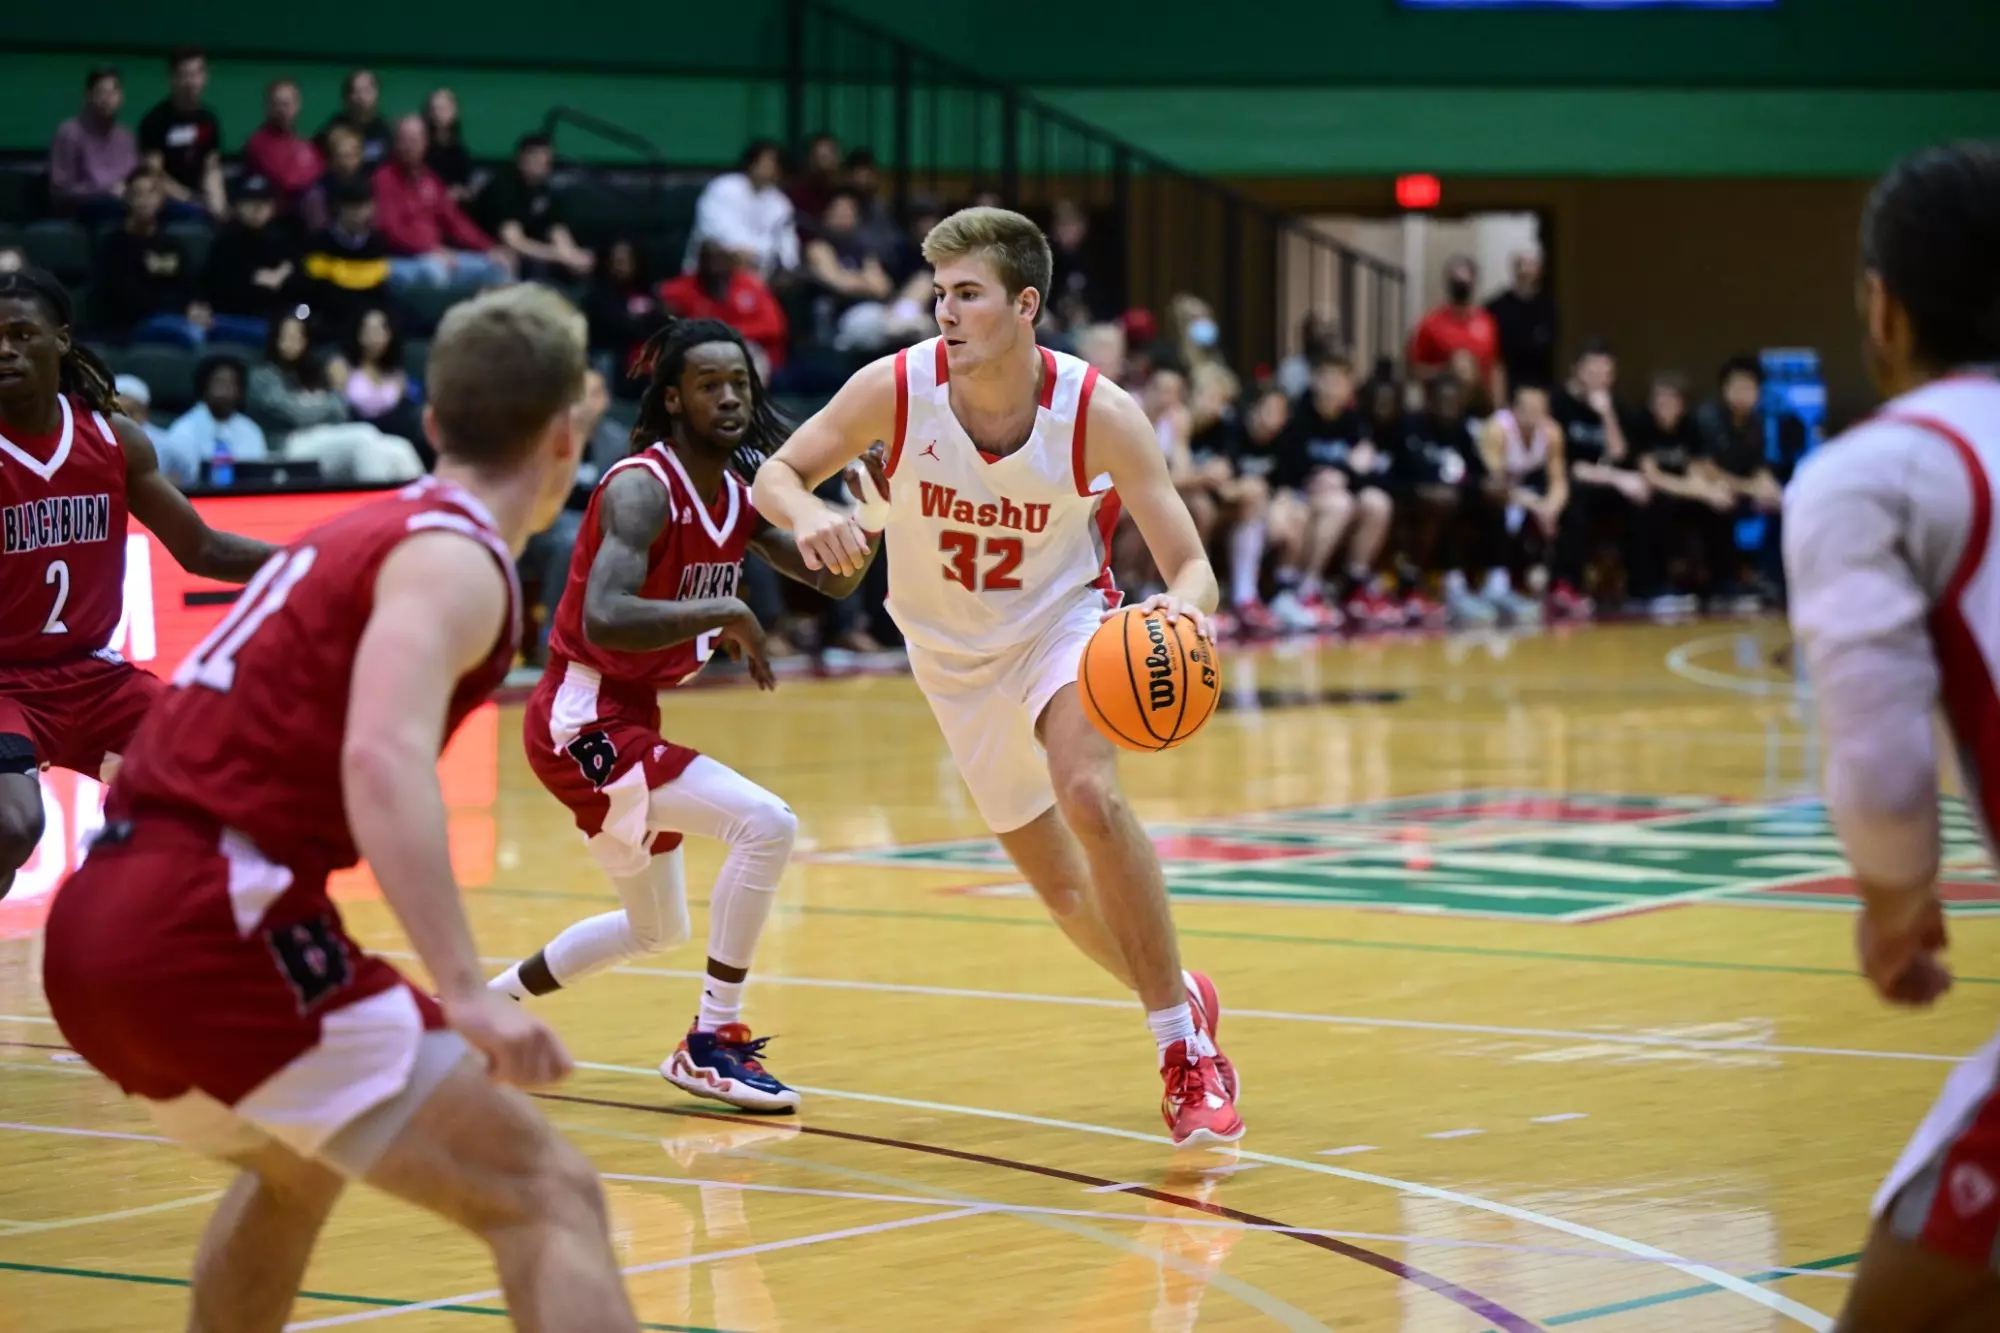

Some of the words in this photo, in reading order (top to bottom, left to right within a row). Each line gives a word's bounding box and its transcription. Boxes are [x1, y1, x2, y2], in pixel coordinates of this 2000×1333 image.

[3, 493, 110, 554] BLACKBURN
[920, 480, 1052, 533] WashU
[939, 529, 1024, 592] 32
[41, 559, 70, 634] 2
[1144, 618, 1176, 712] Wilson
